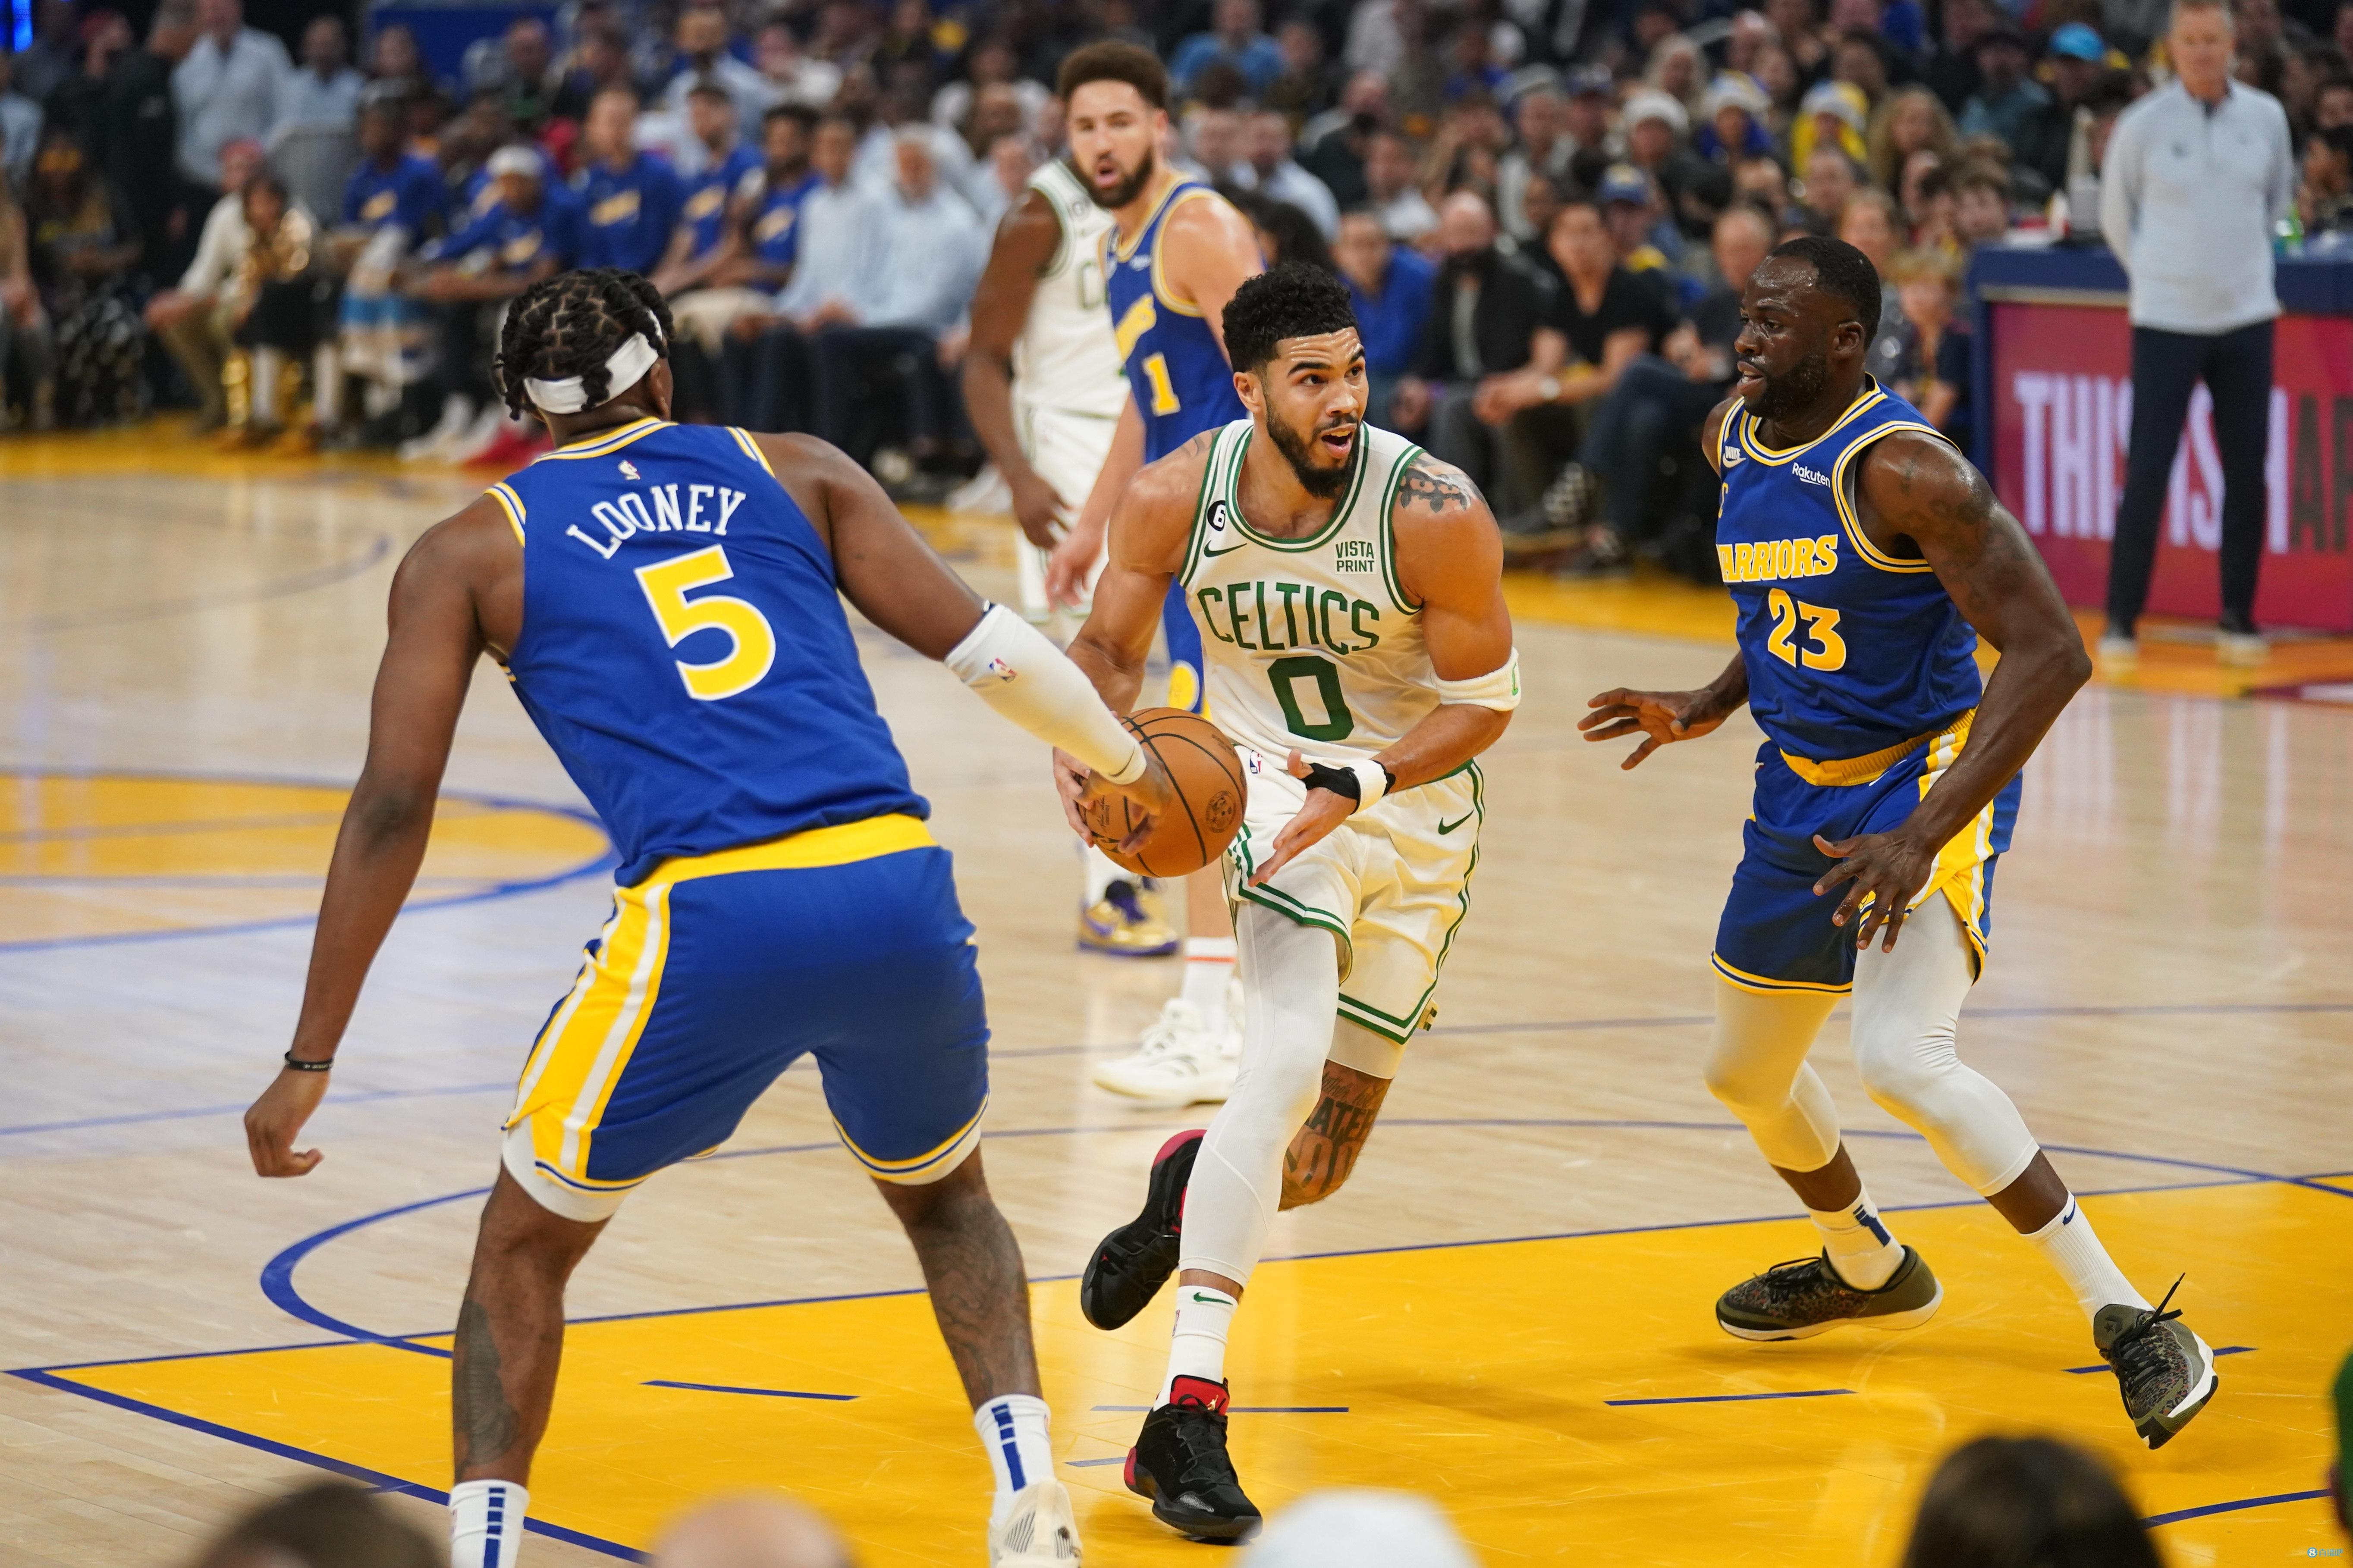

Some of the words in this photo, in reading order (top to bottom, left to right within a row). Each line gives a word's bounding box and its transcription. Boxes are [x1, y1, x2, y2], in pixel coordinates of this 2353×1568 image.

[1143, 351, 1181, 417] 1
[1792, 462, 1831, 488] Rakuten
[565, 483, 746, 559] LOONEY
[1213, 504, 1226, 528] 6
[1335, 541, 1374, 559] VISTA
[1337, 560, 1375, 572] PRINT
[634, 544, 776, 701] 5
[1197, 581, 1380, 655] CELTICS
[1767, 588, 1847, 672] 23
[1267, 655, 1354, 742] 0
